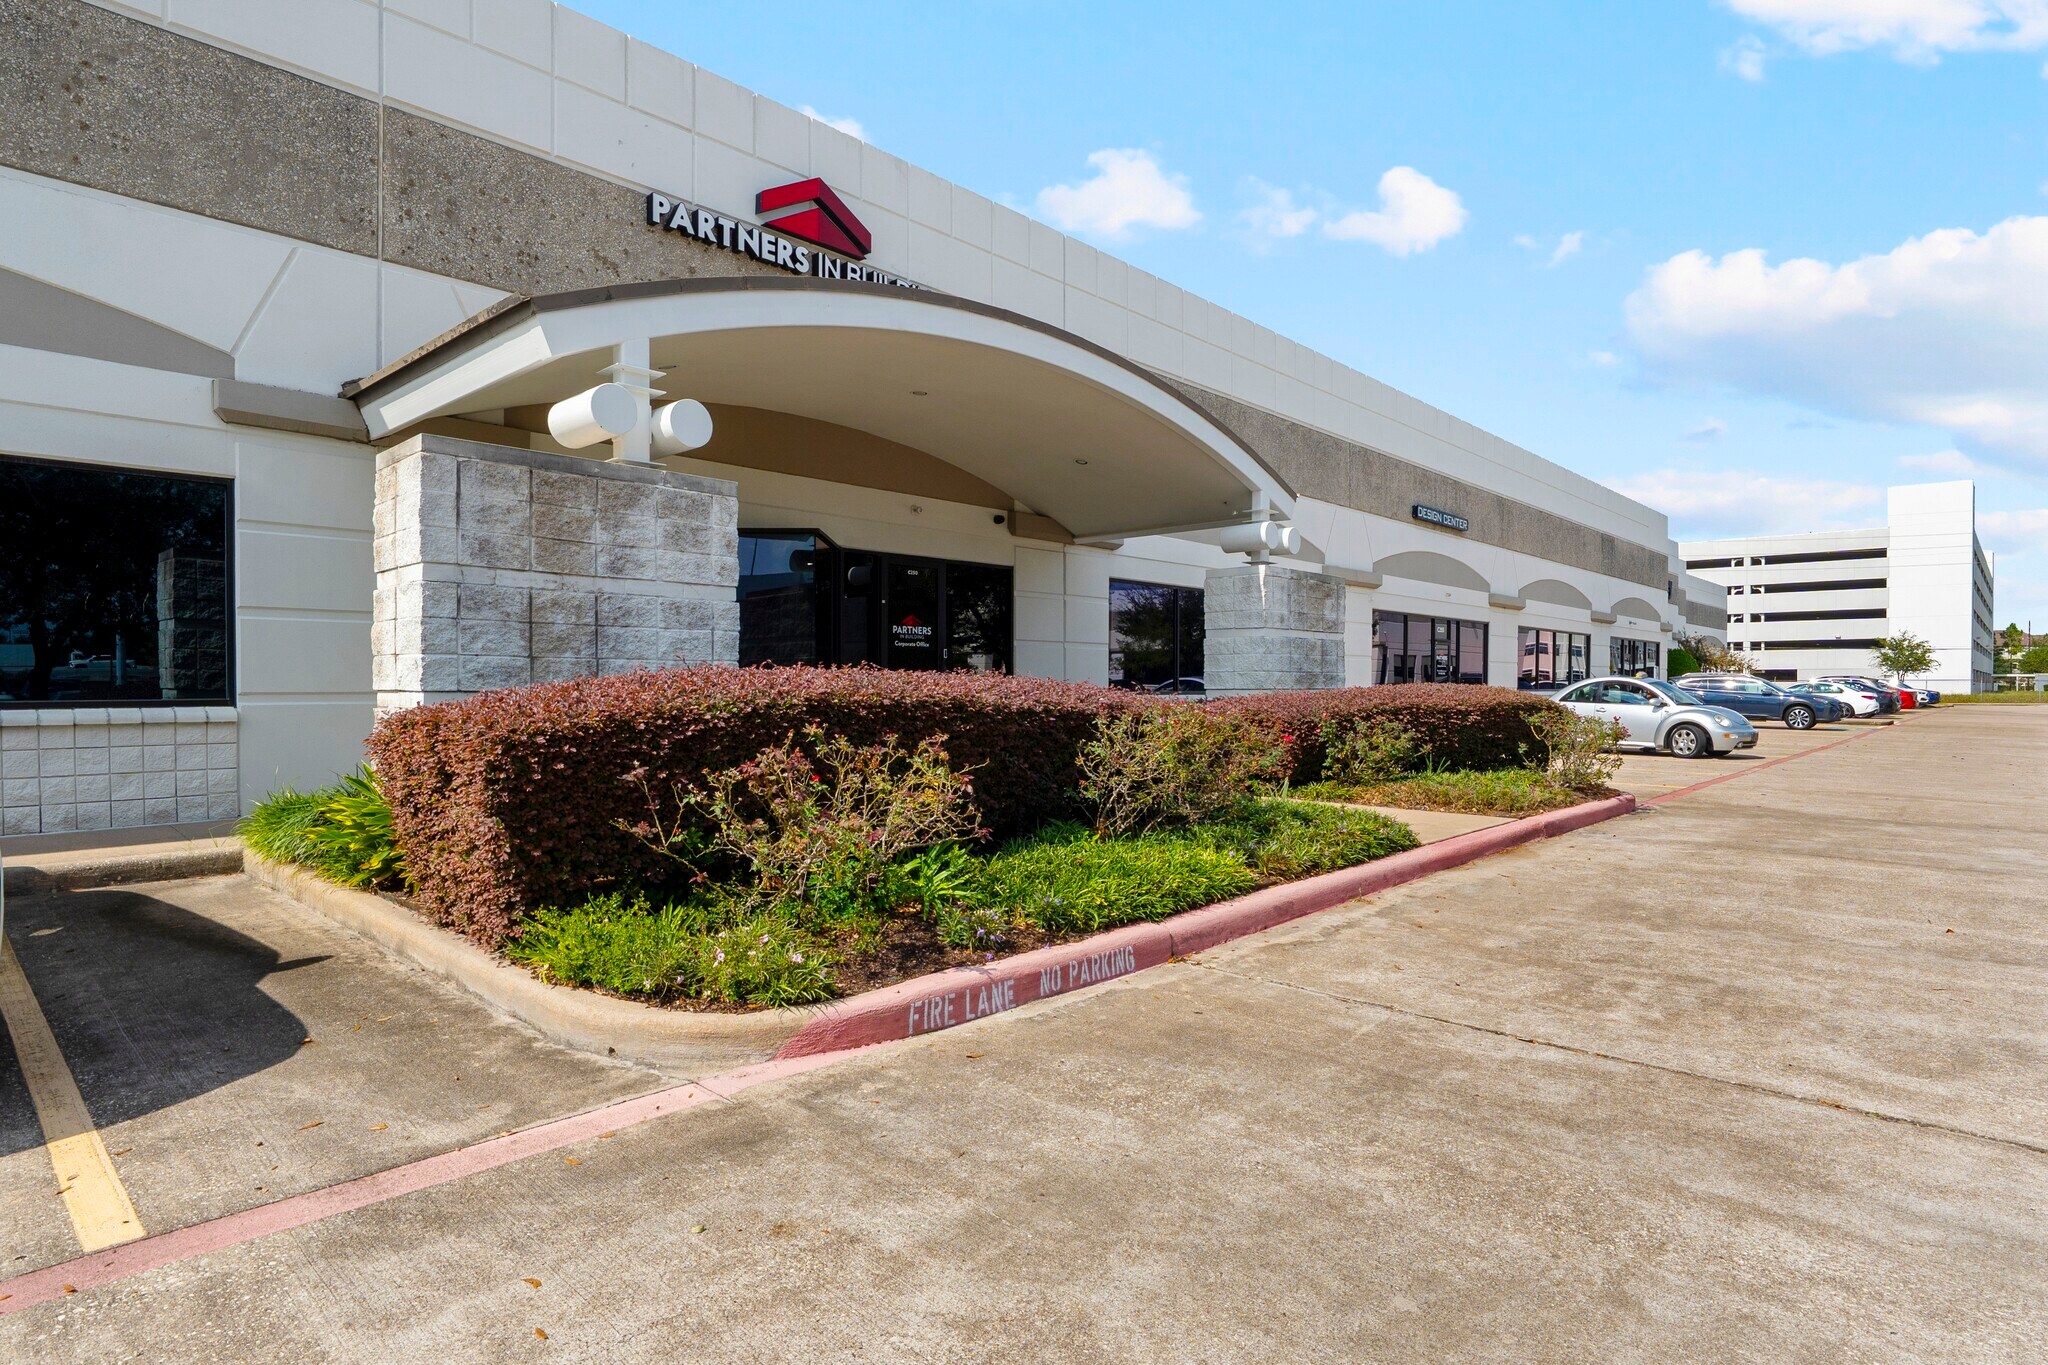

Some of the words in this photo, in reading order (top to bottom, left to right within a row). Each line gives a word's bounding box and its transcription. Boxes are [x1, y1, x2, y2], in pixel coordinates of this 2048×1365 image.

[649, 191, 810, 274] PARTNERS
[816, 252, 841, 280] IN
[1417, 506, 1442, 523] DESIGN
[1443, 514, 1468, 530] CENTER
[892, 625, 932, 635] PARTNERS
[894, 640, 916, 648] Corporate
[908, 991, 957, 1035] FIRE
[965, 978, 1017, 1021] LANE
[1040, 965, 1062, 997] NO
[1069, 945, 1135, 988] PARKING
